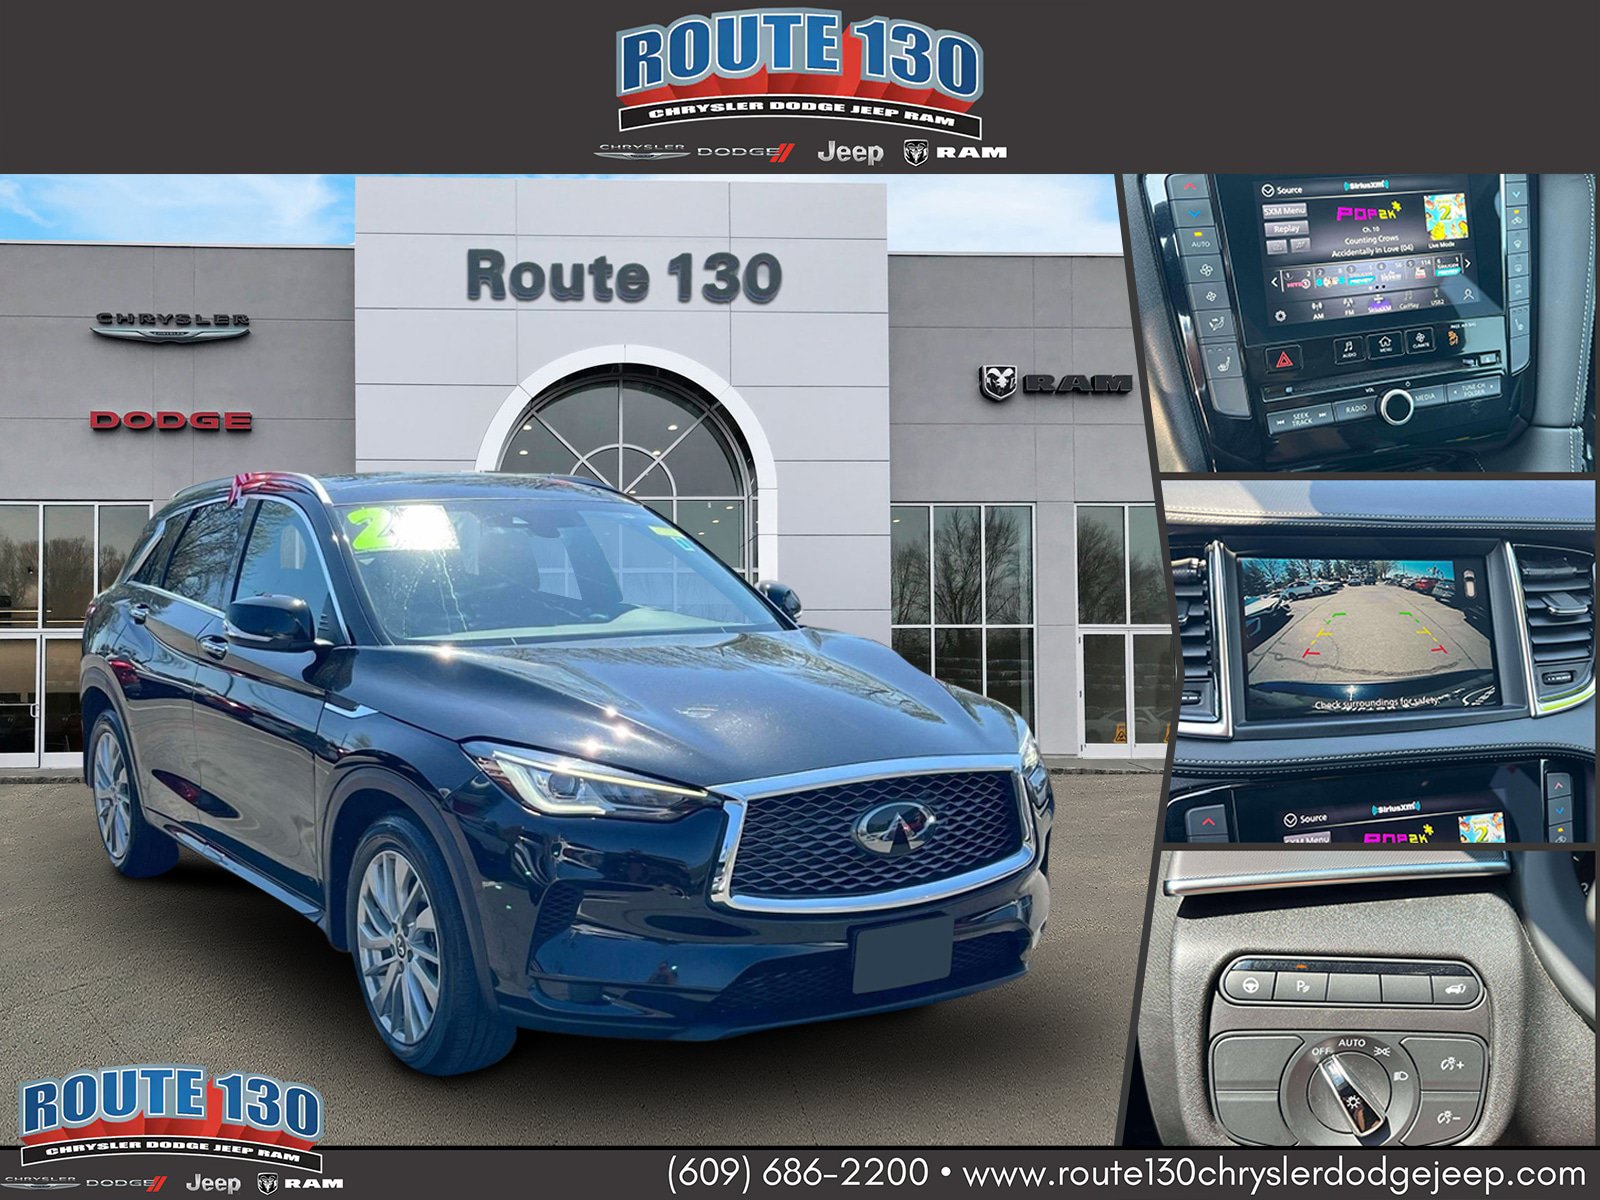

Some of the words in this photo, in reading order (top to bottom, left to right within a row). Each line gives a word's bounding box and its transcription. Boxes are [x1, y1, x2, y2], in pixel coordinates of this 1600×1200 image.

[1276, 186, 1303, 195] Source
[1283, 205, 1306, 215] Menu
[1273, 224, 1300, 234] Replay
[1344, 237, 1379, 246] Counting
[1379, 233, 1400, 242] Crows
[1331, 246, 1375, 258] Accidentally
[1384, 244, 1400, 253] Love
[467, 248, 650, 301] Route
[667, 251, 783, 304] 130
[96, 312, 250, 326] CHRYSLER
[1313, 312, 1325, 320] AM
[1022, 373, 1134, 394] RAM
[1415, 392, 1436, 401] MEDIA
[1345, 404, 1368, 414] RADIO
[90, 410, 252, 432] DODGE
[1292, 412, 1310, 421] SEEK
[1291, 418, 1313, 427] TRACK
[1315, 700, 1342, 711] Check
[1342, 697, 1399, 709] surroundings
[1300, 813, 1328, 824] Source
[1338, 1038, 1367, 1048] AUTO
[1311, 1047, 1332, 1057] OFF
